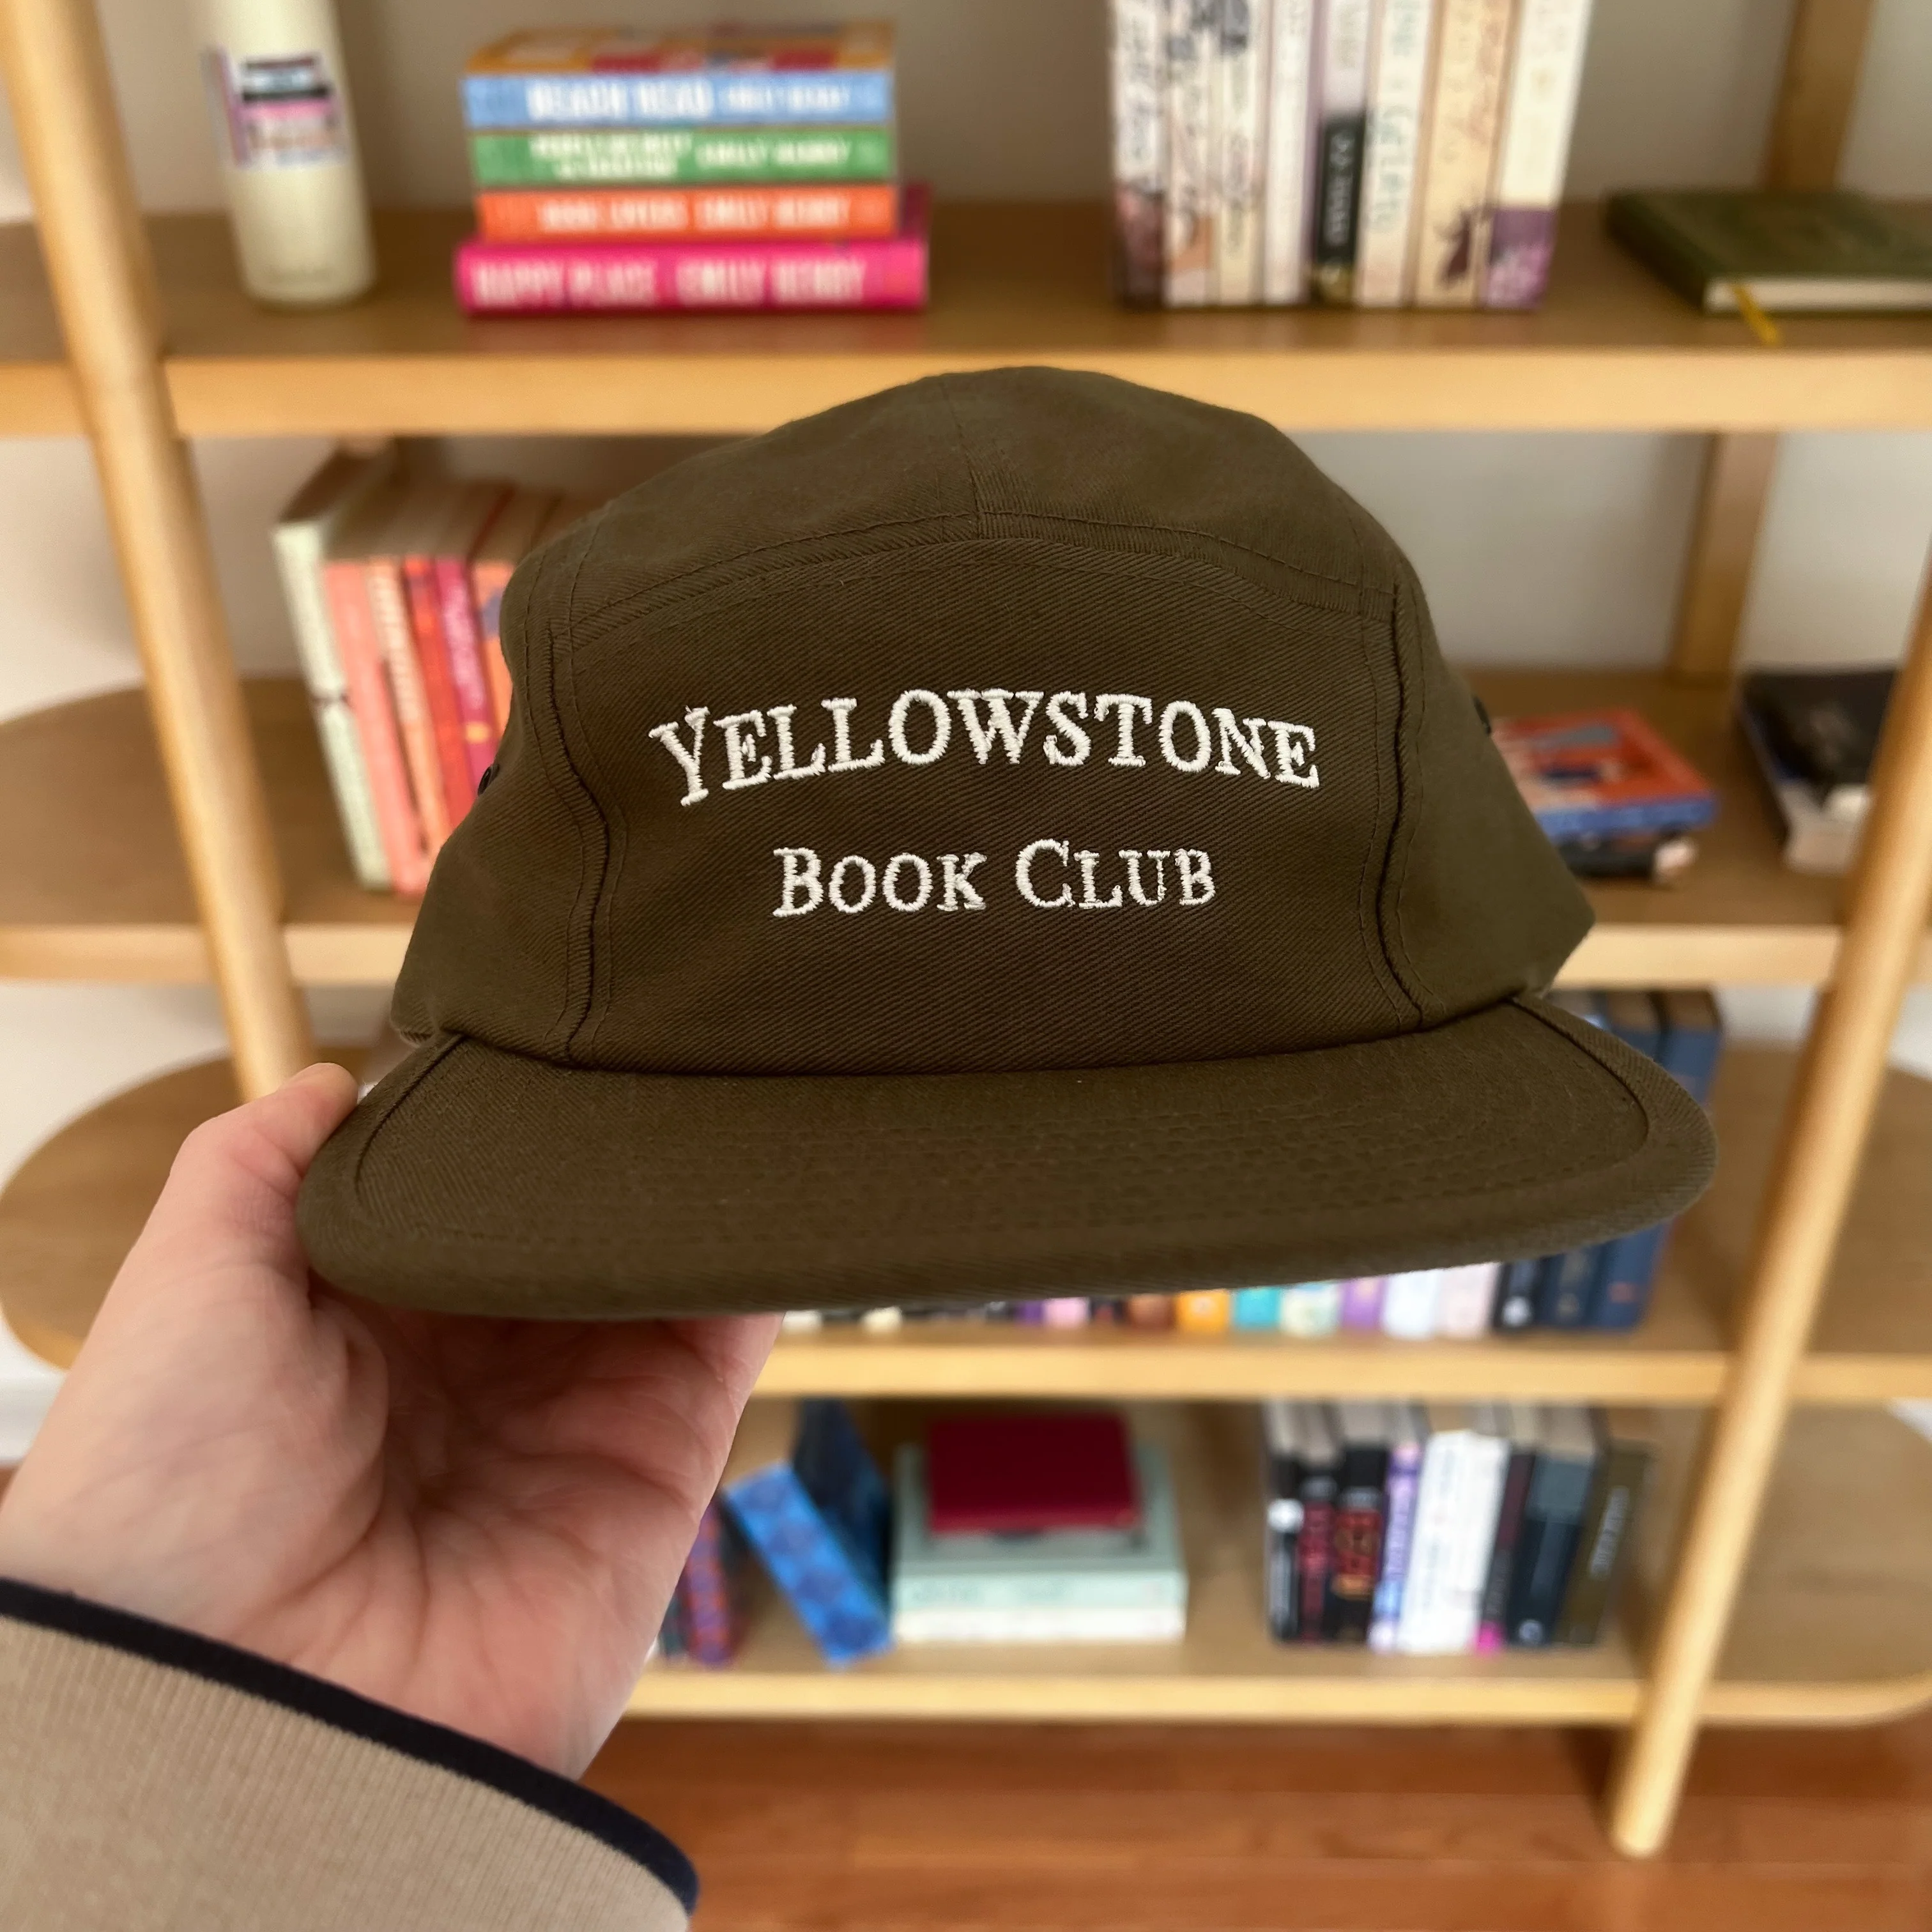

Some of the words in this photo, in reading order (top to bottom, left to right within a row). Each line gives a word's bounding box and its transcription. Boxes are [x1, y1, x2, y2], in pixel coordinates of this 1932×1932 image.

[648, 689, 1320, 806] YELLOWSTONE
[773, 847, 987, 917] BOOK
[1015, 838, 1216, 910] CLUB
